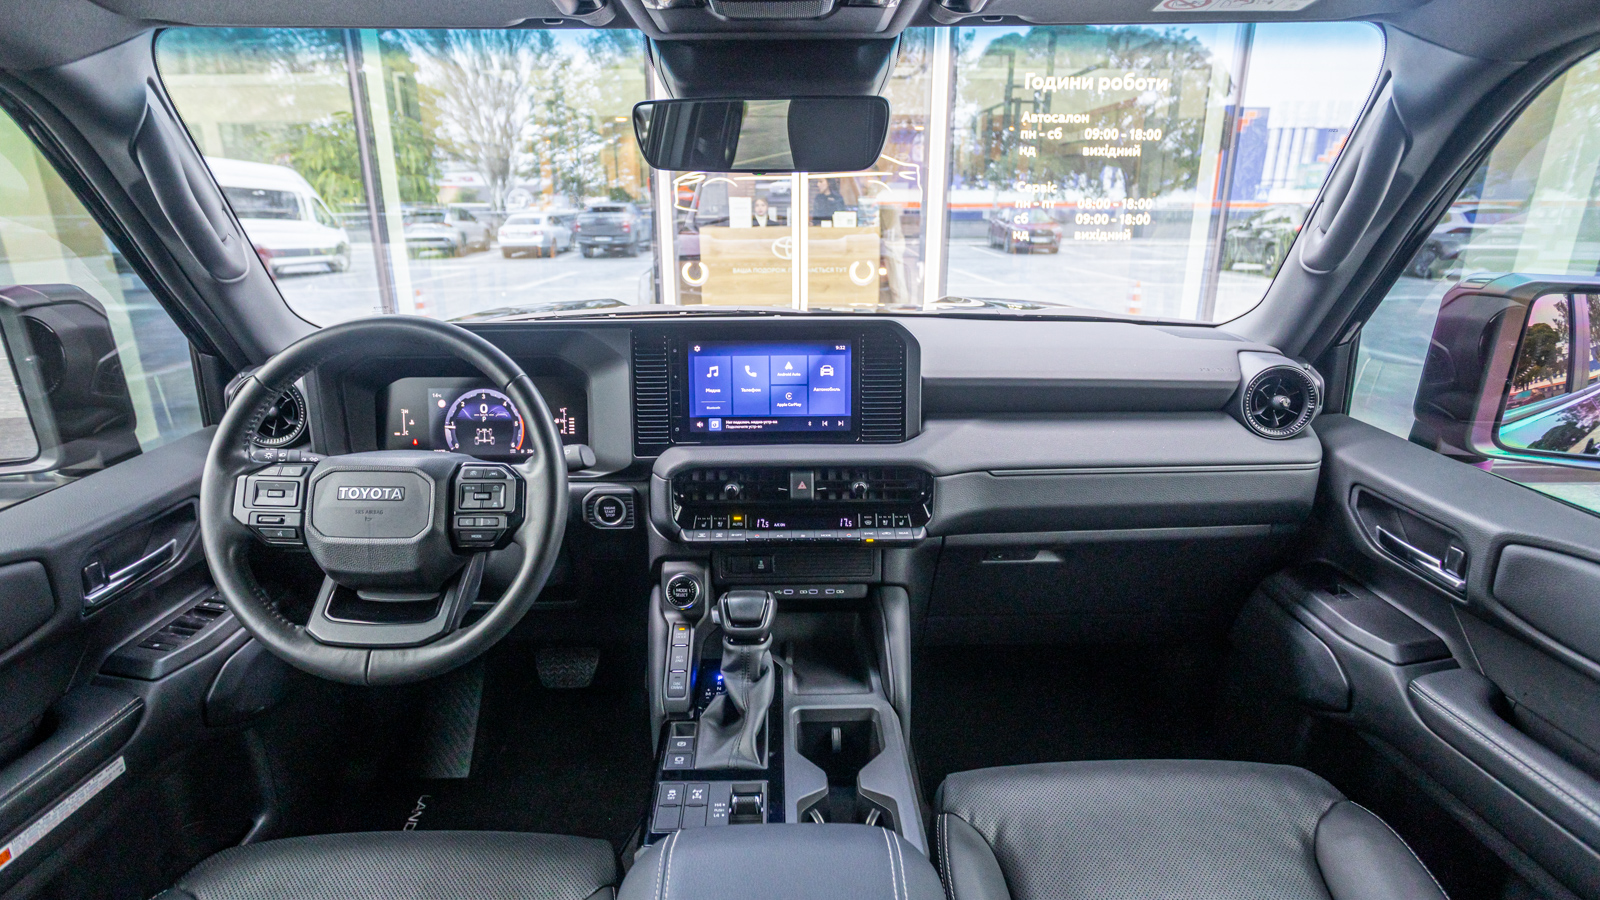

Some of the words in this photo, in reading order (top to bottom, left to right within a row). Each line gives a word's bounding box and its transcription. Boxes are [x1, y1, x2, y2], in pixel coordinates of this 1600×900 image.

[1024, 72, 1094, 93] Години
[1097, 72, 1169, 94] роботи
[1021, 111, 1090, 124] Автосалон
[1020, 129, 1037, 140] пн
[1047, 127, 1063, 140] сб
[1084, 128, 1119, 141] 09:00
[1129, 128, 1162, 141] 18:00
[1019, 146, 1037, 158] нд
[1082, 143, 1142, 159] вихідний
[1016, 181, 1058, 195] Сервіс
[1014, 199, 1032, 209] пн
[1041, 199, 1057, 209] пт
[1077, 198, 1112, 210] 08:00
[1121, 198, 1153, 210] 18:00
[1013, 212, 1029, 225] сб
[1075, 213, 1109, 226] 09:00
[1118, 213, 1151, 226] 18:00
[1012, 230, 1030, 242] нд
[1074, 228, 1131, 242] вихідний
[480, 404, 488, 414] 0
[338, 487, 402, 500] TOYOTA
